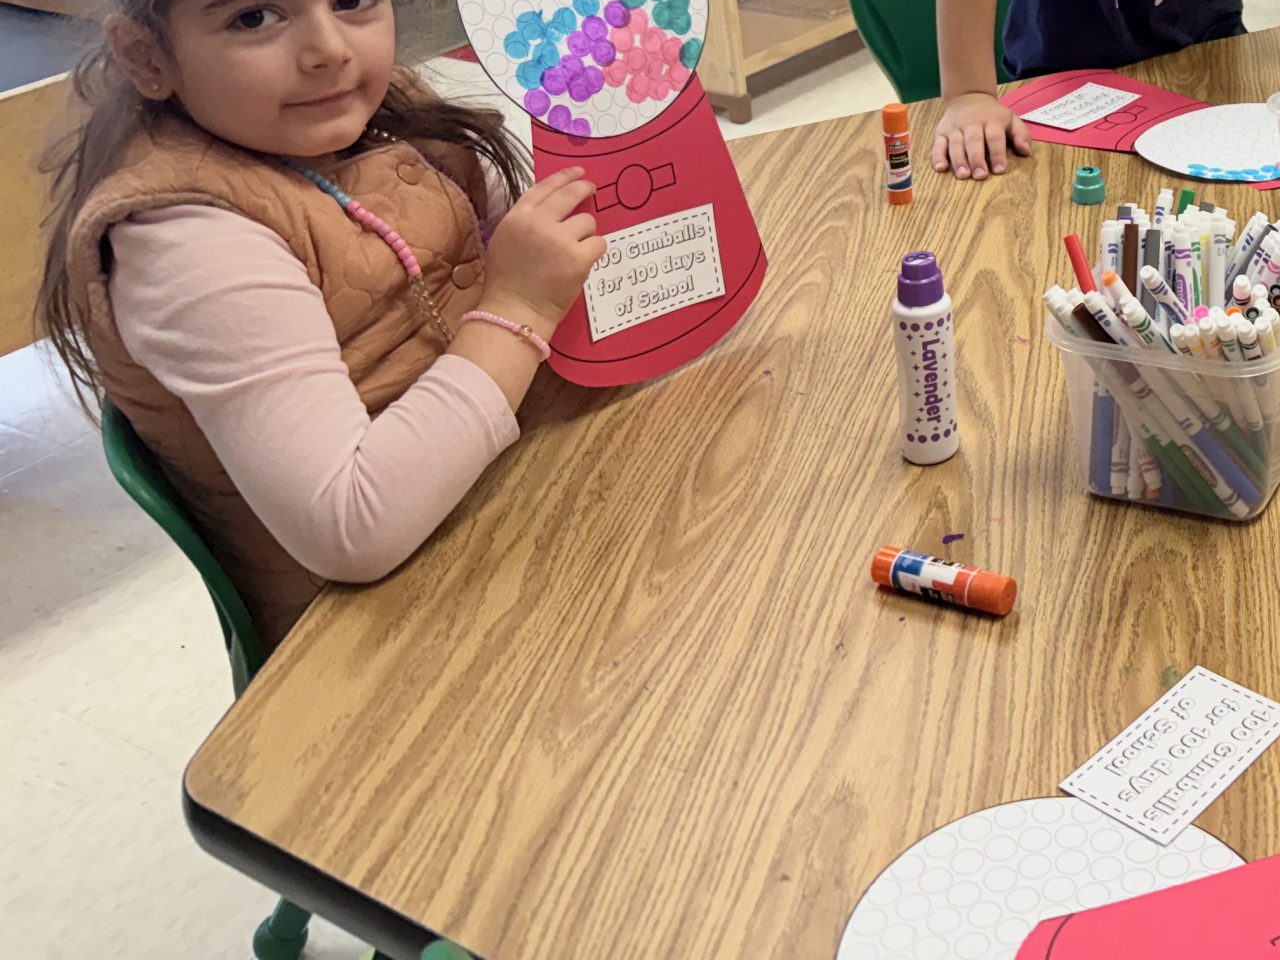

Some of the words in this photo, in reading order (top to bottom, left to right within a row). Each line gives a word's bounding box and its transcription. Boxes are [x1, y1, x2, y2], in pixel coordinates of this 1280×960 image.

[626, 223, 706, 260] Gumballs
[596, 276, 624, 297] for
[627, 263, 659, 286] 100
[660, 249, 706, 274] days
[614, 298, 634, 317] of
[637, 274, 696, 309] School
[921, 337, 944, 425] Lavender
[1169, 697, 1197, 721] of
[1204, 697, 1241, 726] for
[1230, 708, 1272, 743] 100
[1104, 717, 1178, 777] School
[1168, 725, 1211, 762] 100
[1117, 757, 1174, 803] days
[1142, 742, 1237, 822] Gumballs
